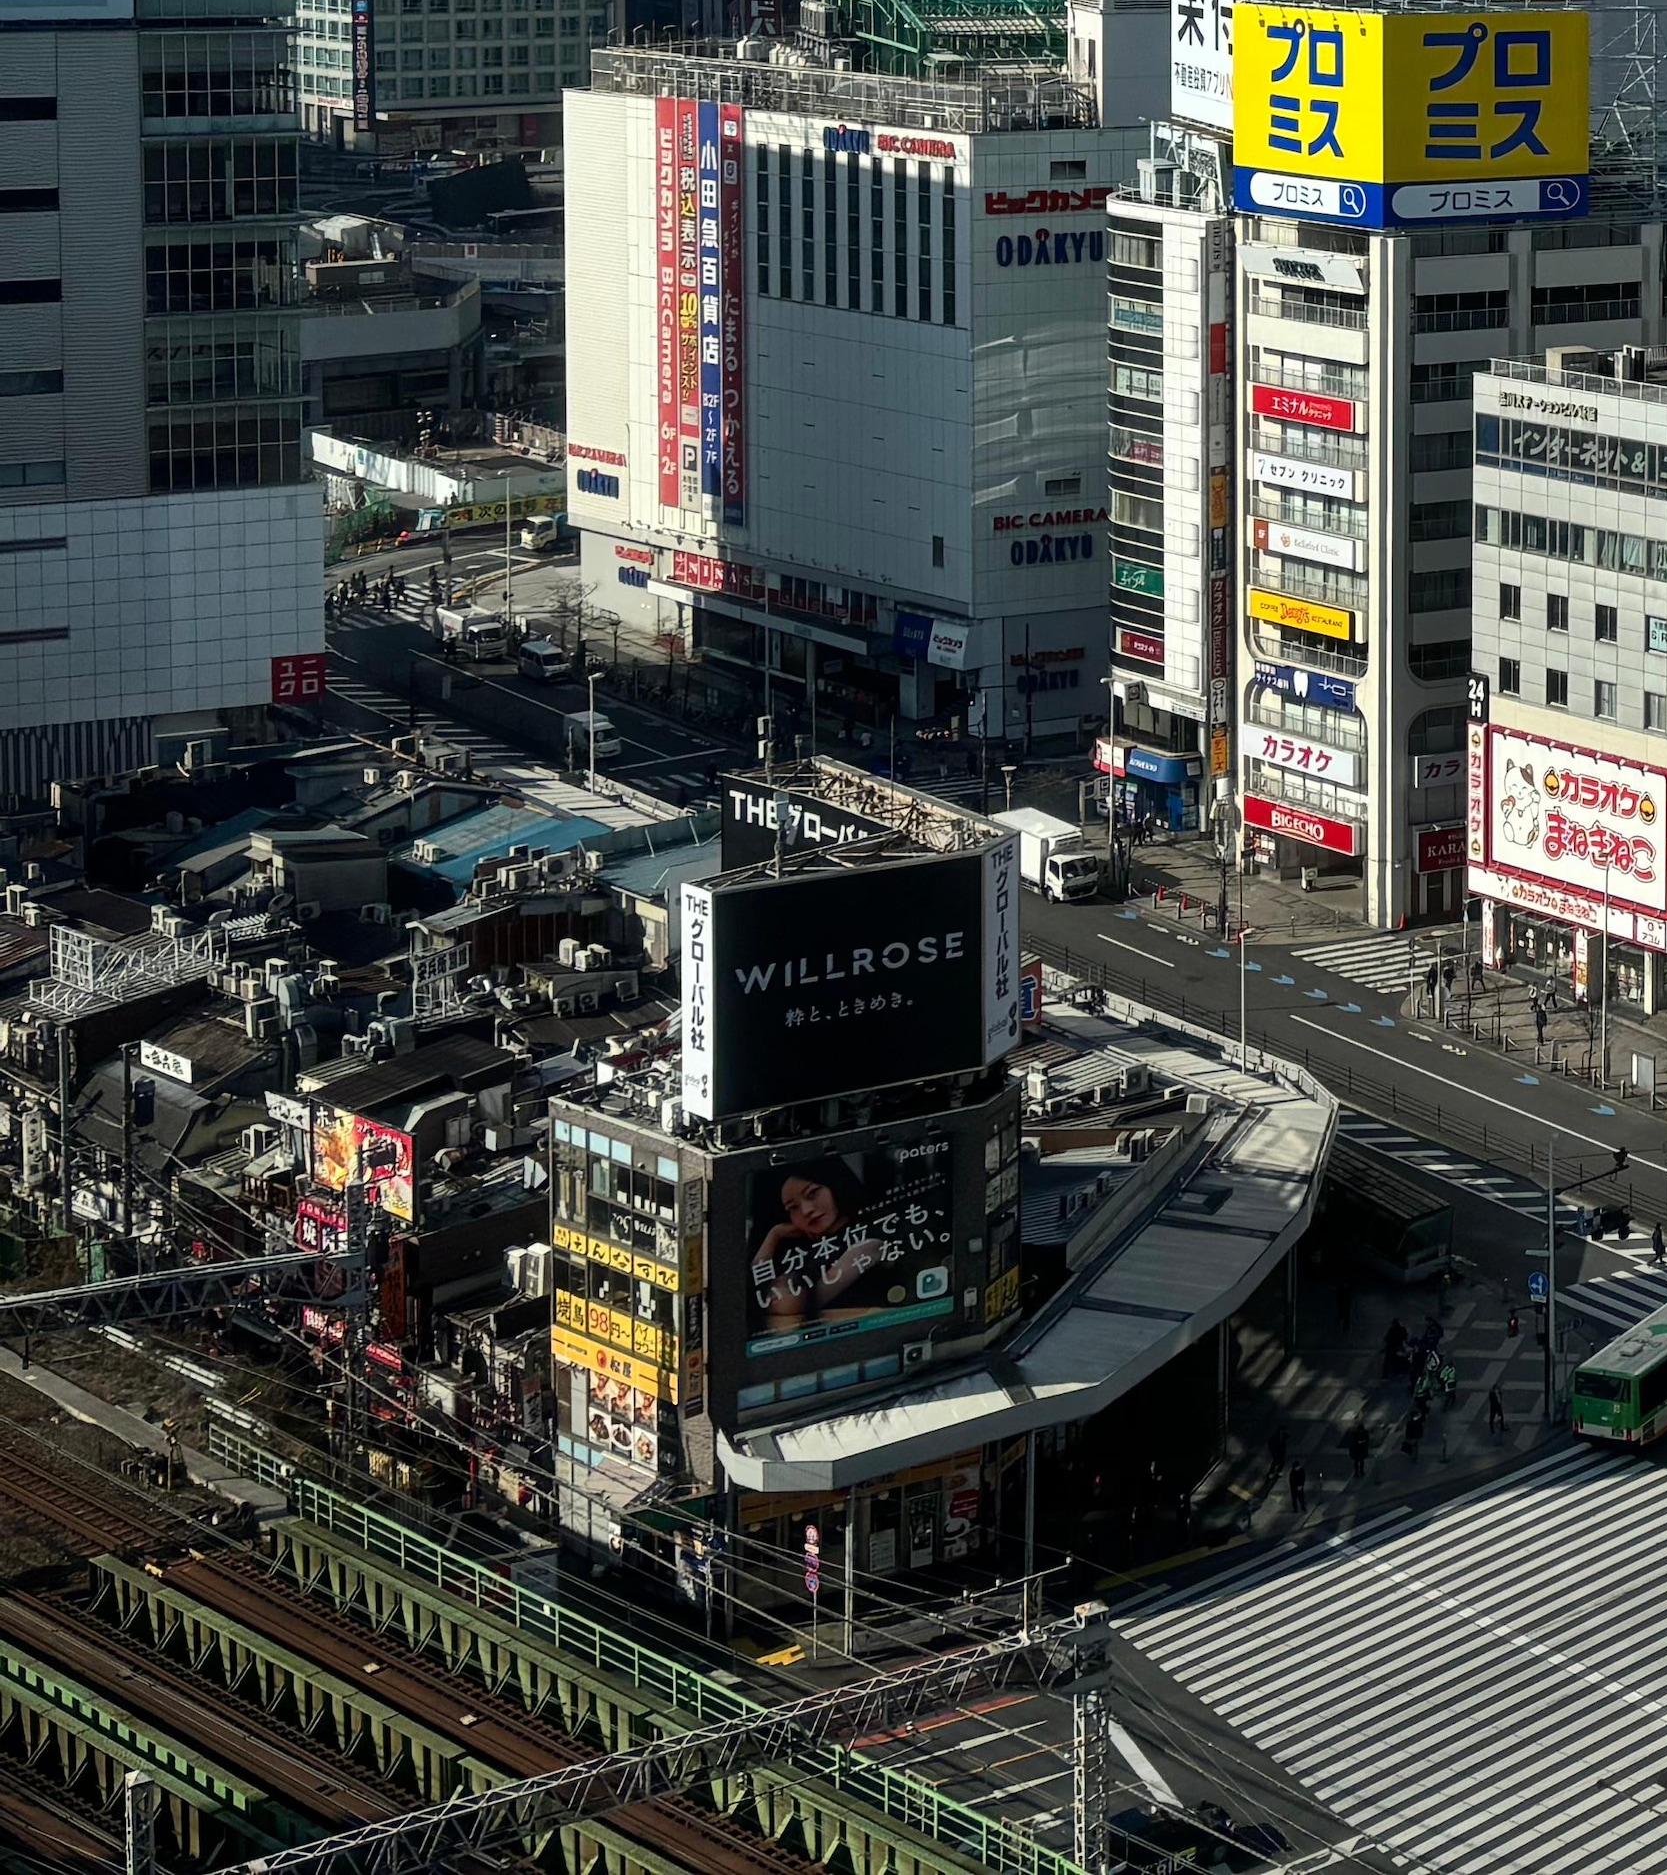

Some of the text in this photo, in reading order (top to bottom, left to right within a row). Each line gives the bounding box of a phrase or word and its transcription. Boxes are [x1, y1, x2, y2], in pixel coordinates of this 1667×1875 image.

[1266, 19, 1343, 87] プロ
[1423, 22, 1551, 92] プロ
[1268, 95, 1344, 159] ミス
[1425, 100, 1550, 160] ミス
[660, 128, 674, 251] ビックカメラ
[985, 187, 1114, 215] ビックカメラ
[1272, 182, 1324, 207] プロミス
[1429, 188, 1514, 212] プロミス
[680, 166, 697, 268] 税込表示
[701, 140, 720, 365] 小田急百貨店
[996, 228, 1103, 267] ODAKYU
[1272, 396, 1308, 416] エミナル
[1514, 429, 1629, 472] インターネット
[1630, 451, 1646, 474] &
[1270, 463, 1295, 479] セブン
[1301, 469, 1345, 489] クリニック
[993, 507, 1108, 531] BIC CAMERA
[1010, 532, 1093, 566] ODAKYU
[1280, 602, 1310, 625] Denny's
[279, 676, 318, 696] クロ
[280, 660, 318, 678] ユニ
[1468, 679, 1484, 701] 24
[1471, 702, 1481, 718] H
[1262, 735, 1333, 773] カラオケ
[1470, 751, 1482, 836] カラオケ
[1558, 770, 1640, 818] カラオケ
[991, 843, 1014, 868] THE
[1543, 806, 1656, 883] まねきねこ
[685, 894, 709, 916] THE
[1517, 884, 1552, 908] カラオケ
[735, 931, 965, 994] WILLROSE
[690, 920, 706, 1053] グローバル社
[899, 1141, 949, 1163] paters
[751, 1203, 945, 1286] 自分本位でも、
[755, 1229, 950, 1309] いいじゃない。
